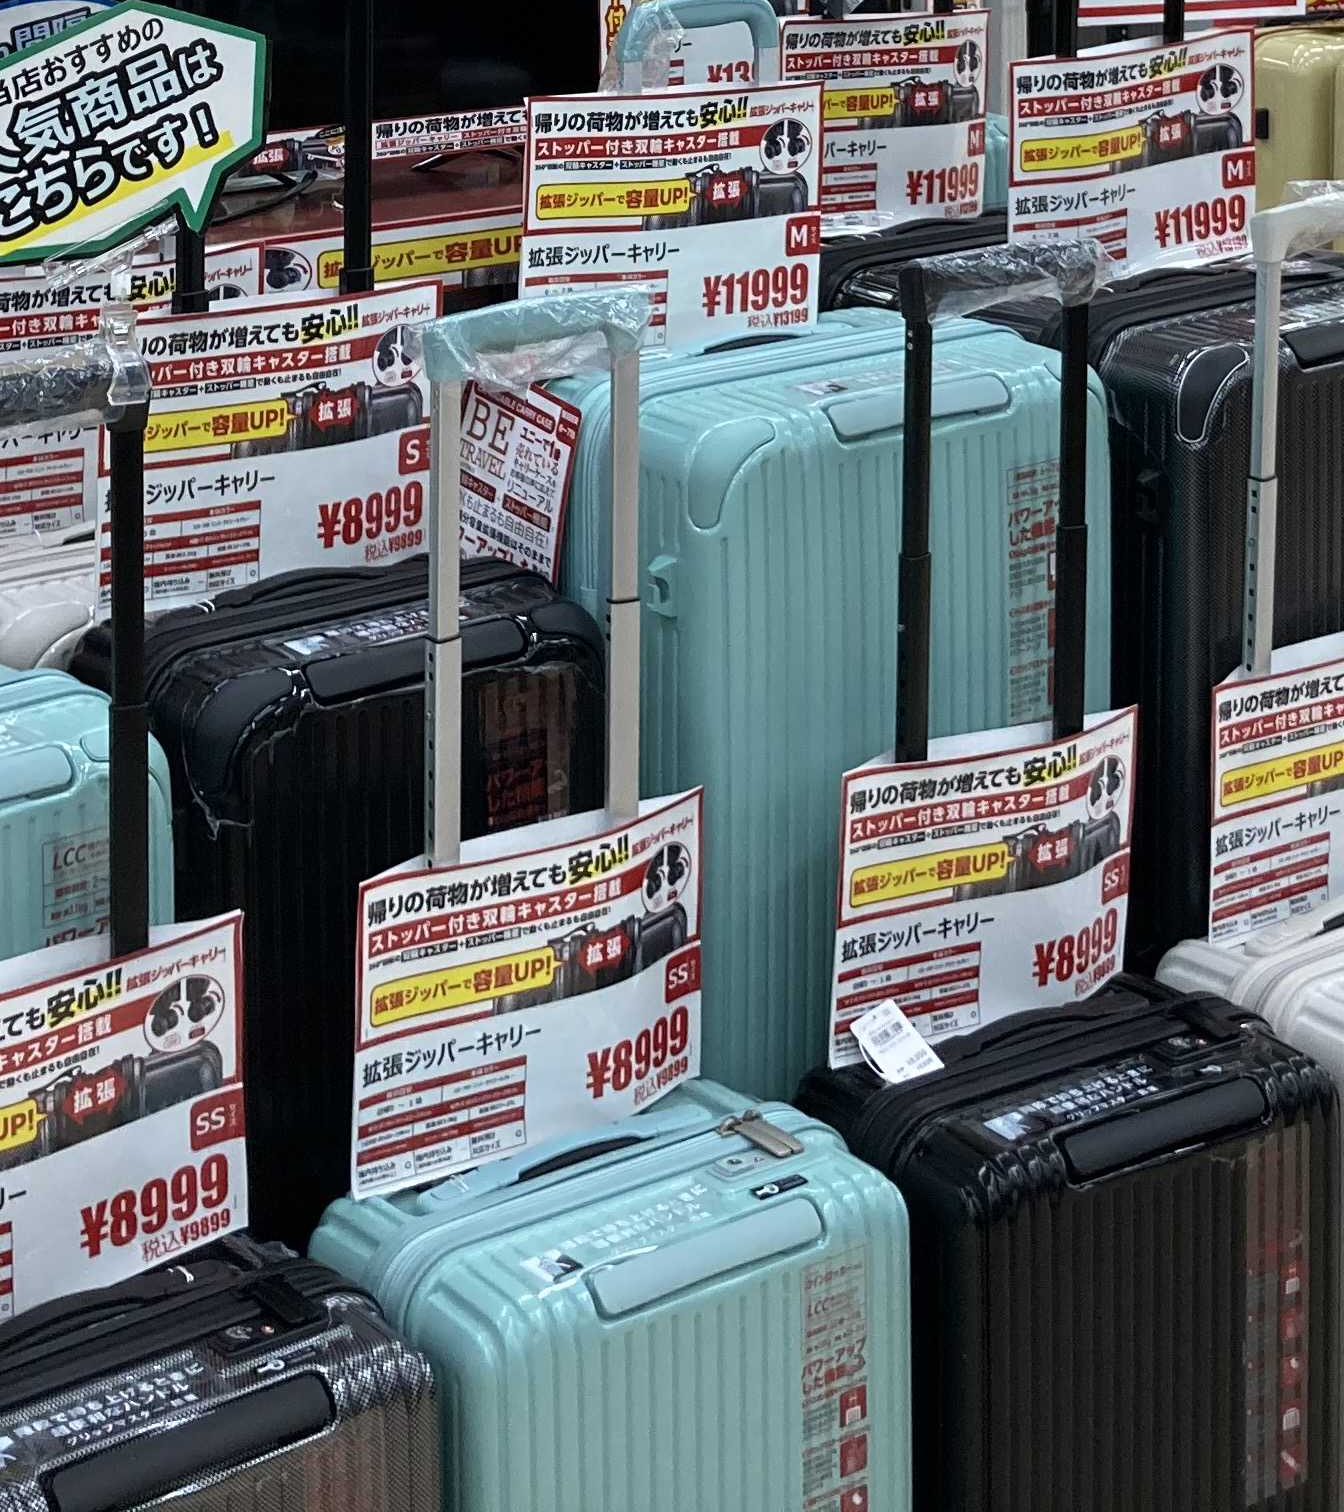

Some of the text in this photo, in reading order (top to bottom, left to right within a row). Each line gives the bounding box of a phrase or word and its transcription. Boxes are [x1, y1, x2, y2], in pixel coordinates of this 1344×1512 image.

[534, 96, 749, 135] 帰りの荷物が増えても安心!!
[906, 162, 980, 206] ¥11999
[1225, 159, 1244, 181] M
[1015, 185, 1136, 215] 拡張ジッパーキャリー
[1154, 194, 1246, 250] ¥11999
[527, 244, 680, 268] 拡張ジッパーキャリー
[789, 223, 808, 246] M
[702, 262, 809, 319] ¥11999
[404, 435, 422, 462] S
[317, 481, 423, 548] ¥8999
[1215, 806, 1341, 857] 拡張ジッパーキャリー
[368, 833, 630, 928] 帰りの荷物が増えても安心!!
[841, 912, 995, 963] 拡張ジッパーキャリー
[1032, 907, 1119, 987] ¥8999
[374, 955, 552, 1015] 拡張ジッパーで容量UP!
[667, 961, 689, 990] SS
[362, 1023, 542, 1088] 拡張ジッパーキャリー
[586, 1005, 689, 1099] ¥8999
[72, 1076, 116, 1115] 拡張
[195, 1105, 225, 1136] SS
[79, 1152, 229, 1259] ¥8999
